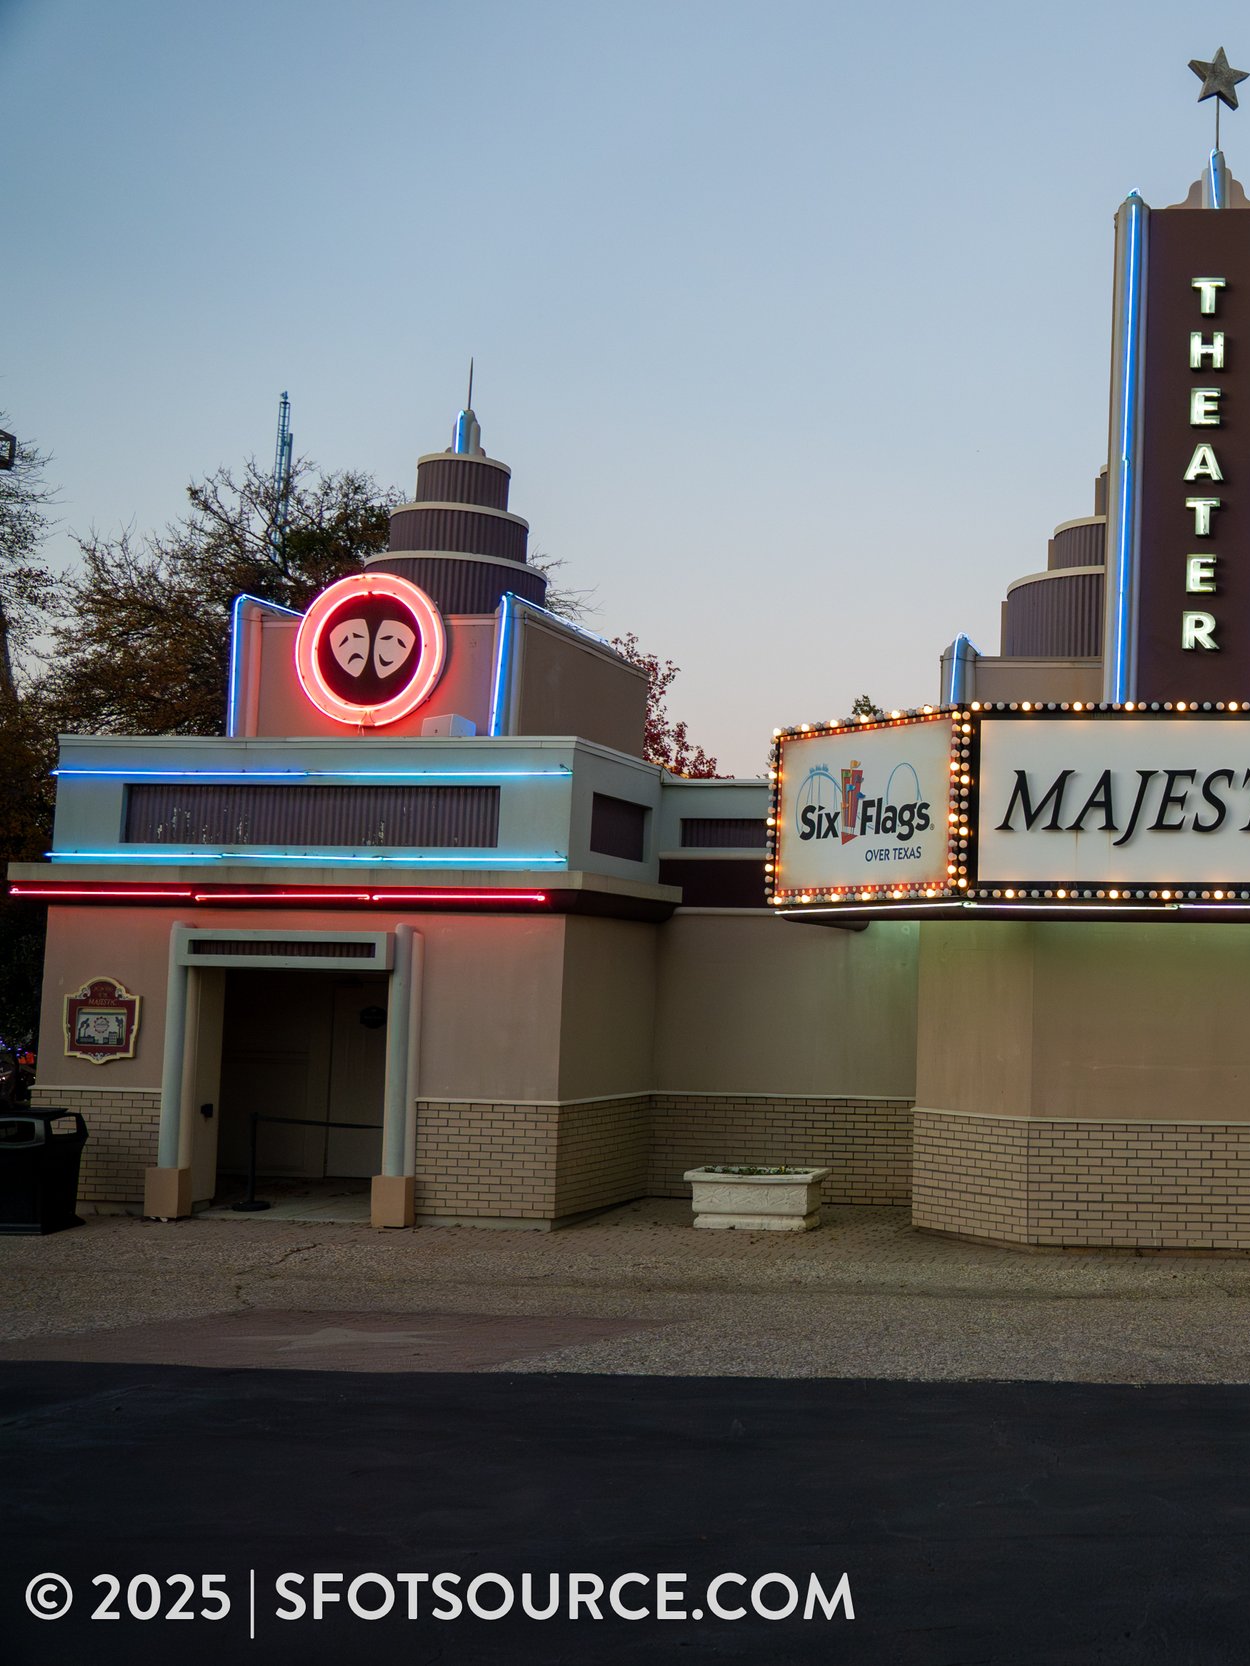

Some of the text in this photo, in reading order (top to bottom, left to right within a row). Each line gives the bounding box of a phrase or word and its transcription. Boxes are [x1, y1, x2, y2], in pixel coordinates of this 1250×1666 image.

[1181, 277, 1227, 651] THEATER
[799, 805, 841, 841] Six
[865, 846, 922, 862] OVER TEXAS
